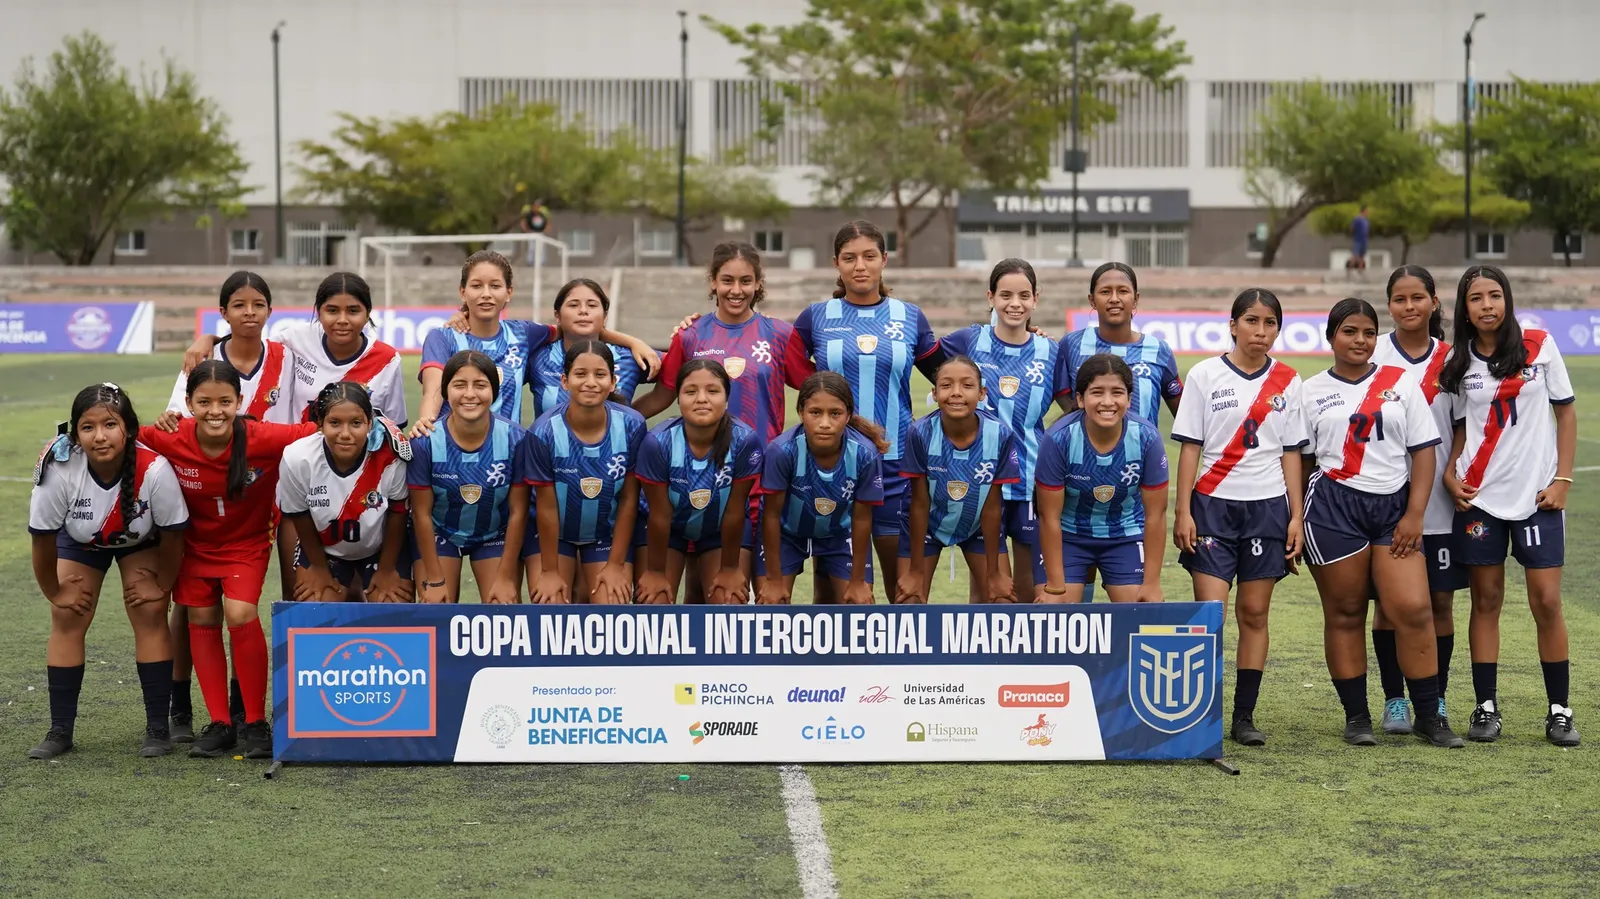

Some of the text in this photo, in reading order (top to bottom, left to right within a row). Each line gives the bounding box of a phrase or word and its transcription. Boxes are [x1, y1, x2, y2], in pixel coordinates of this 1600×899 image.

[994, 196, 1152, 213] TRIBUNA ESTE
[1211, 388, 1236, 400] DOLORES
[1211, 399, 1239, 413] CACUANGO
[1490, 397, 1518, 429] 11
[1242, 418, 1260, 449] 8
[1349, 411, 1385, 443] 21
[212, 496, 225, 517] 1
[328, 518, 361, 543] 10
[1524, 525, 1541, 547] 11
[1251, 537, 1263, 556] 8
[1438, 547, 1450, 570] 9
[450, 612, 1112, 656] COPA NACIONAL INTERCOLEGIAL MARATHON
[298, 665, 427, 687] marathon
[532, 686, 617, 697] Presentado por:
[701, 683, 748, 693] BANCO
[787, 686, 847, 703] deuna!
[903, 683, 965, 693] Universidad
[1003, 690, 1065, 703] Pronaca
[334, 691, 391, 705] SPORTS
[701, 695, 775, 705] PICHINCHA
[903, 695, 986, 705] de Las Américas
[527, 707, 623, 724] JUNTA DE
[528, 727, 668, 745] BENEFICENCIA
[703, 721, 759, 736] SPORADE
[927, 722, 979, 738] Hispana
[1019, 723, 1057, 741] PONY
